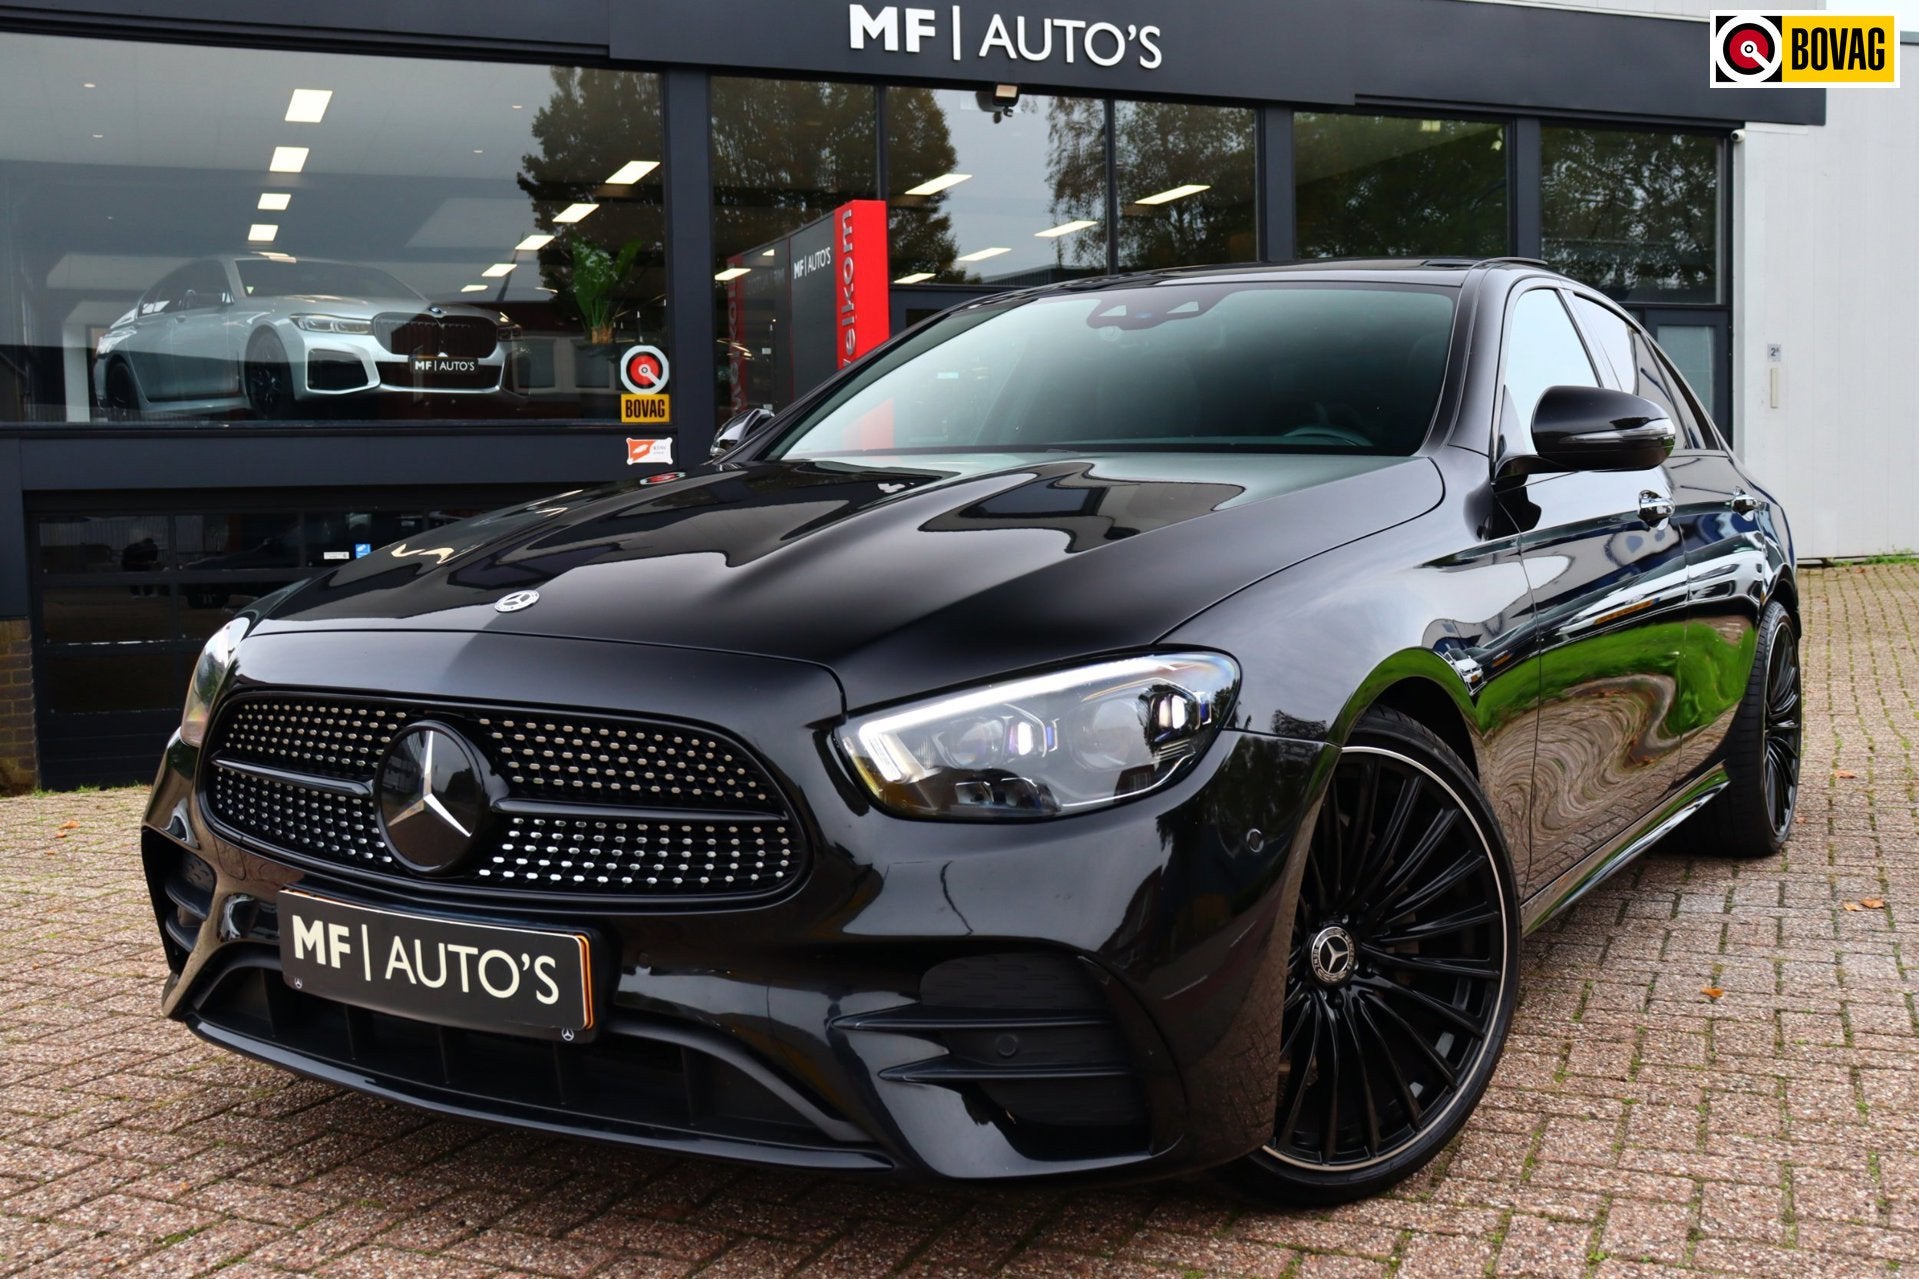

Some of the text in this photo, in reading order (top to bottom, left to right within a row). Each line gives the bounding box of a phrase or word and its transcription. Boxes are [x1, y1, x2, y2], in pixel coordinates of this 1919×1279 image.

[850, 4, 1162, 69] MF AUTO'S
[793, 259, 804, 279] MF
[841, 209, 856, 367] elkom
[414, 360, 475, 372] MF AUTO'S
[625, 399, 665, 418] BOVAG
[292, 914, 560, 1005] MF AUTO'S
